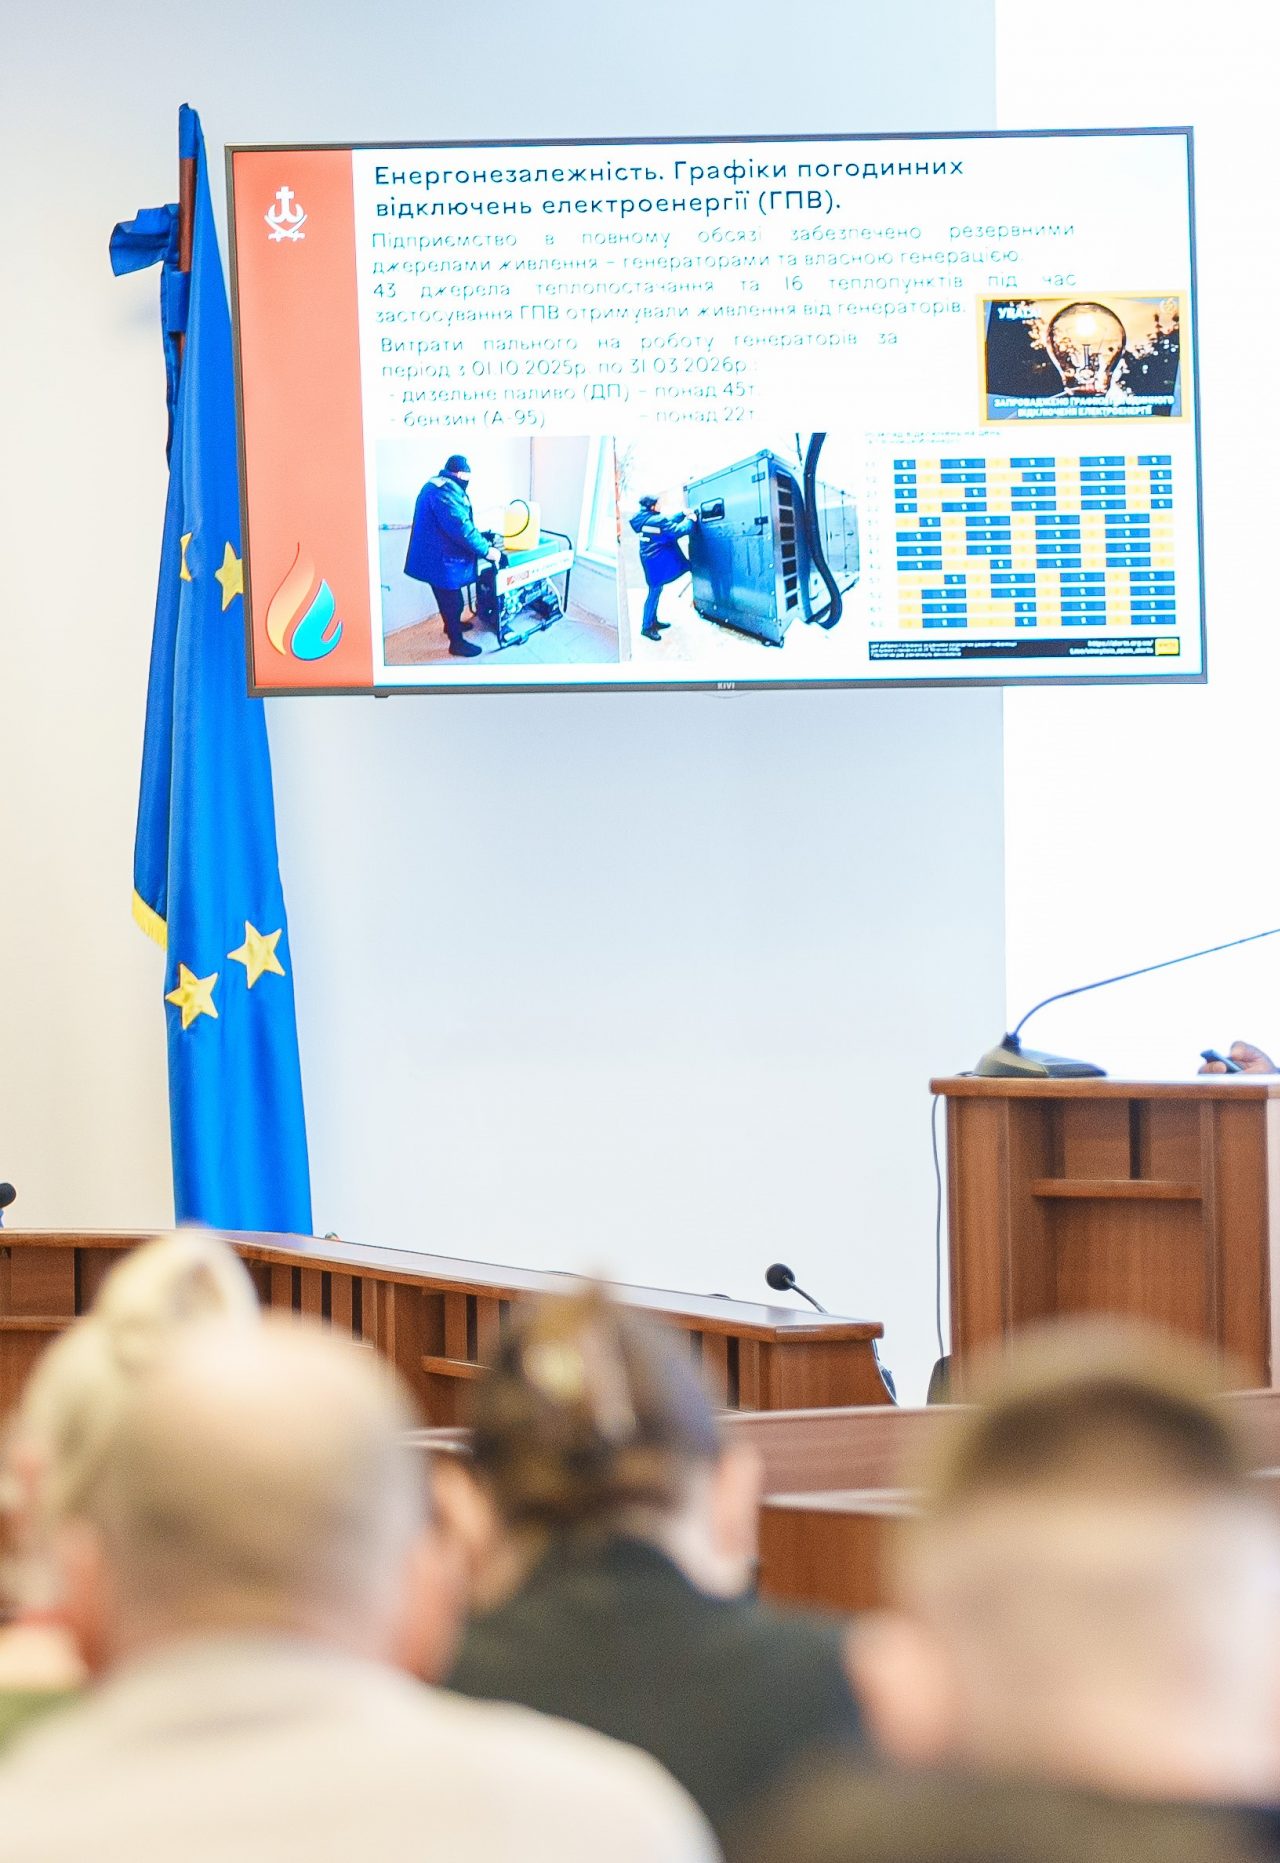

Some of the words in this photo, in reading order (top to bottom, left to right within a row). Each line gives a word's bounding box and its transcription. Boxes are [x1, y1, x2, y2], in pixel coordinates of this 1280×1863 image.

[375, 161, 664, 190] Енергонезалежність.
[675, 158, 786, 185] Графіки
[798, 160, 964, 179] погодинних
[376, 196, 532, 218] відключень
[542, 190, 747, 218] електроенергії
[758, 189, 840, 214] (ГПВ).
[372, 232, 517, 251] Підприємство
[545, 234, 555, 246] в
[582, 232, 670, 248] повному
[698, 226, 762, 242] обсязі
[790, 225, 922, 241] забезпечено
[949, 225, 1075, 240] резервними
[372, 258, 491, 278] джерелами
[499, 258, 598, 270] живлення
[623, 253, 770, 272] генераторами
[778, 254, 797, 266] та
[804, 251, 892, 266] власною
[373, 283, 396, 299] 43
[420, 282, 511, 300] джерела
[536, 280, 713, 295] теплопостачання
[740, 278, 759, 291] та
[785, 276, 803, 291] 16
[827, 275, 964, 295] теплопунктів
[988, 273, 1017, 289] під
[1042, 273, 1076, 286] час
[375, 309, 512, 327] застосування
[520, 305, 558, 320] ГПВ
[566, 304, 688, 323] отримували
[697, 301, 796, 317] живлення
[804, 300, 831, 316] від
[838, 298, 966, 317] генераторів.
[381, 337, 463, 356] Витрати
[484, 337, 577, 352] пального
[598, 336, 620, 349] на
[640, 333, 714, 352] роботу
[734, 333, 857, 348] генераторів
[878, 333, 897, 345] за
[458, 364, 465, 376] з
[402, 388, 496, 404] дизельне
[504, 386, 575, 401] паливо
[583, 382, 630, 403] (ДП)
[655, 383, 717, 400] понад
